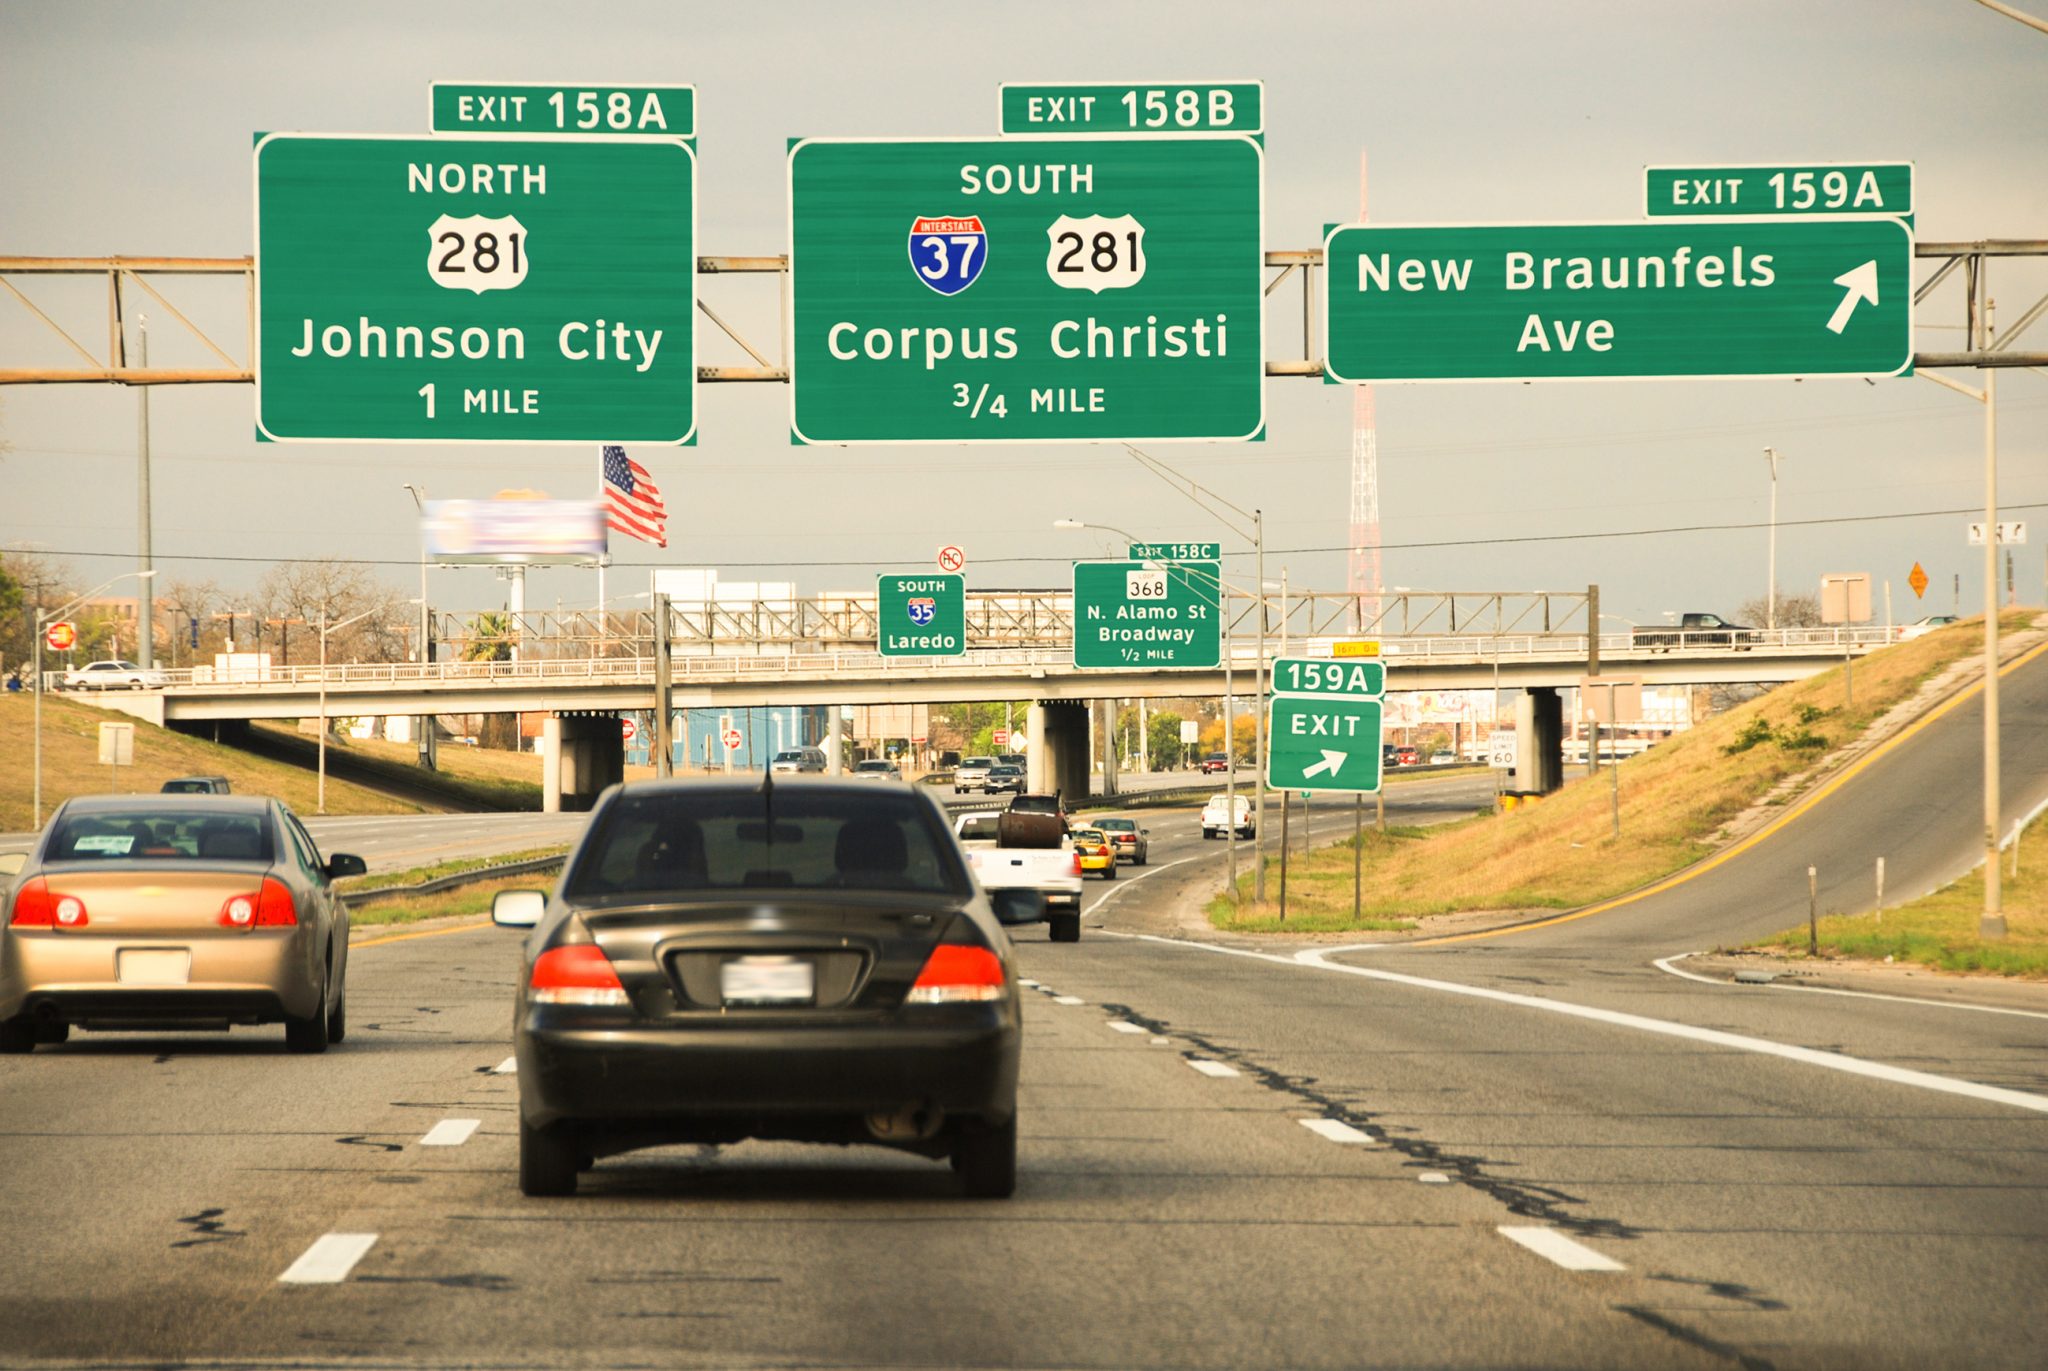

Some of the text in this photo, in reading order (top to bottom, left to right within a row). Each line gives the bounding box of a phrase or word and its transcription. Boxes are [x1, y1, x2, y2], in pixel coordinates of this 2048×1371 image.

[458, 92, 667, 130] EXIT 158A
[1028, 89, 1236, 127] EXIT 158B
[408, 163, 546, 194] NORTH
[960, 164, 1094, 195] SOUTH
[1673, 171, 1884, 209] EXIT 159A
[920, 221, 975, 231] INTERSTATE
[438, 231, 519, 273] 281
[921, 236, 979, 280] 37
[1056, 231, 1138, 273] 281
[1358, 246, 1775, 292] New Braunfels
[291, 317, 663, 372] Johnson City
[827, 314, 1228, 370] Corpus Christi
[1517, 314, 1615, 353] Ave
[418, 383, 539, 418] 1 MILE
[952, 383, 1105, 418] 3/4 MILE
[1171, 544, 1211, 558] 158C
[897, 581, 946, 592] SOUTH
[1130, 581, 1164, 597] 368
[911, 605, 934, 621] 35
[1087, 604, 1206, 619] N. Alamo St
[888, 633, 956, 649] Laredo
[1099, 626, 1195, 645] Broadway
[1121, 648, 1175, 662] 1/2 MILE
[1287, 663, 1368, 692] 159A
[1291, 714, 1361, 737] EXIT
[1494, 752, 1513, 763] 60
